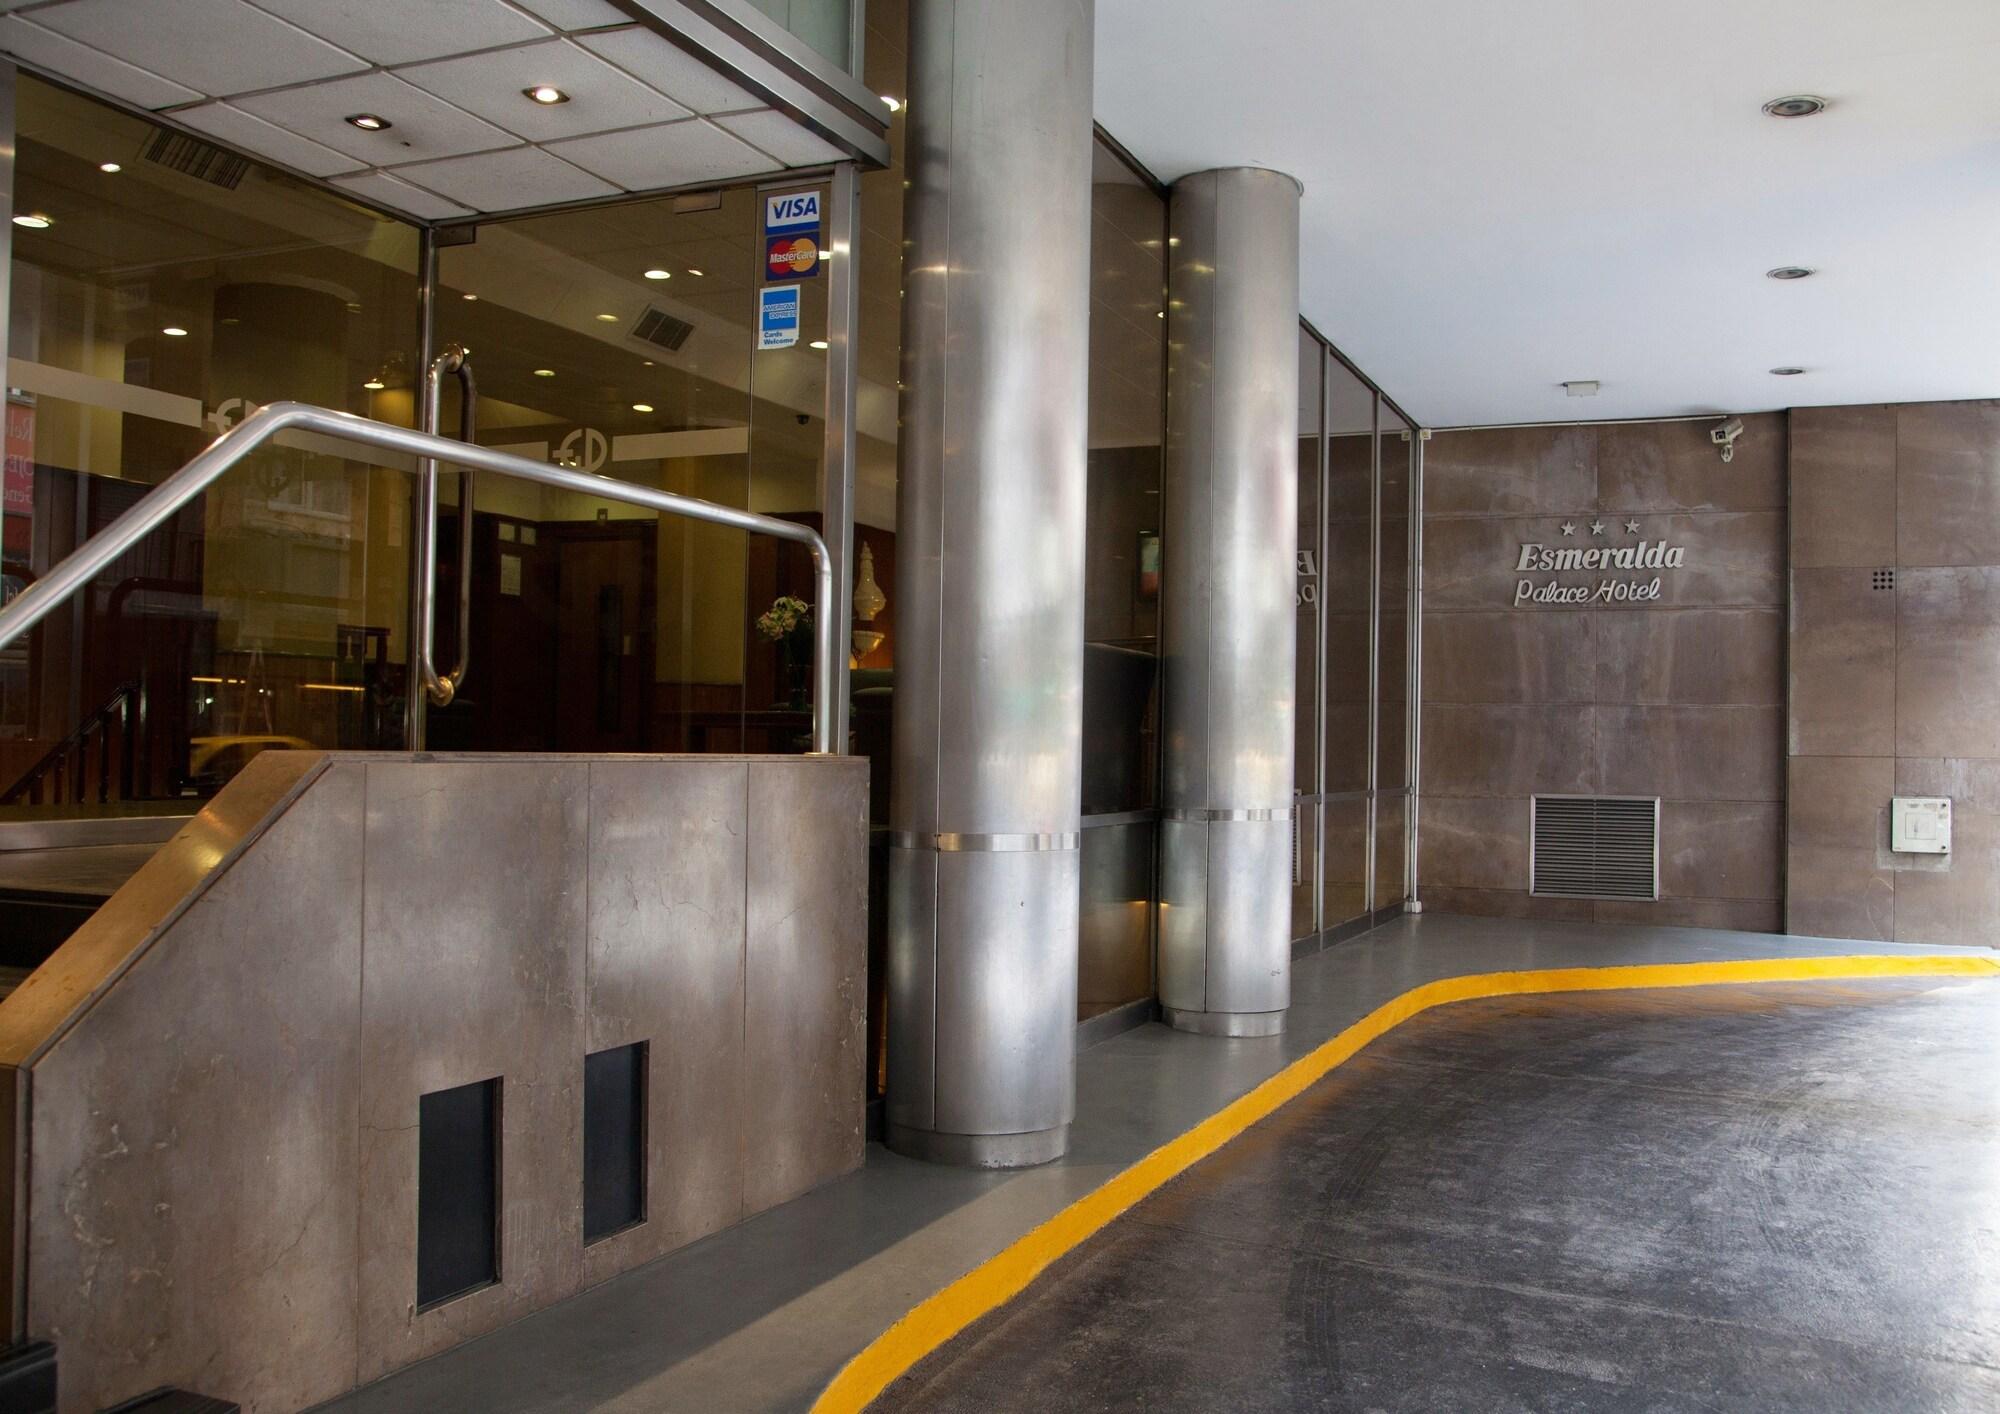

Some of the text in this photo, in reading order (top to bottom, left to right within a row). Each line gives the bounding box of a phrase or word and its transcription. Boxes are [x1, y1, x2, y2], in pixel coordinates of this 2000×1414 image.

[772, 197, 817, 219] VISA
[769, 251, 817, 264] MasterCard
[763, 303, 796, 312] AMERICAN
[764, 330, 783, 339] Cards
[763, 337, 794, 346] Welcome
[1514, 539, 1686, 572] Esmeralda
[1512, 577, 1661, 608] Palace Hotel
